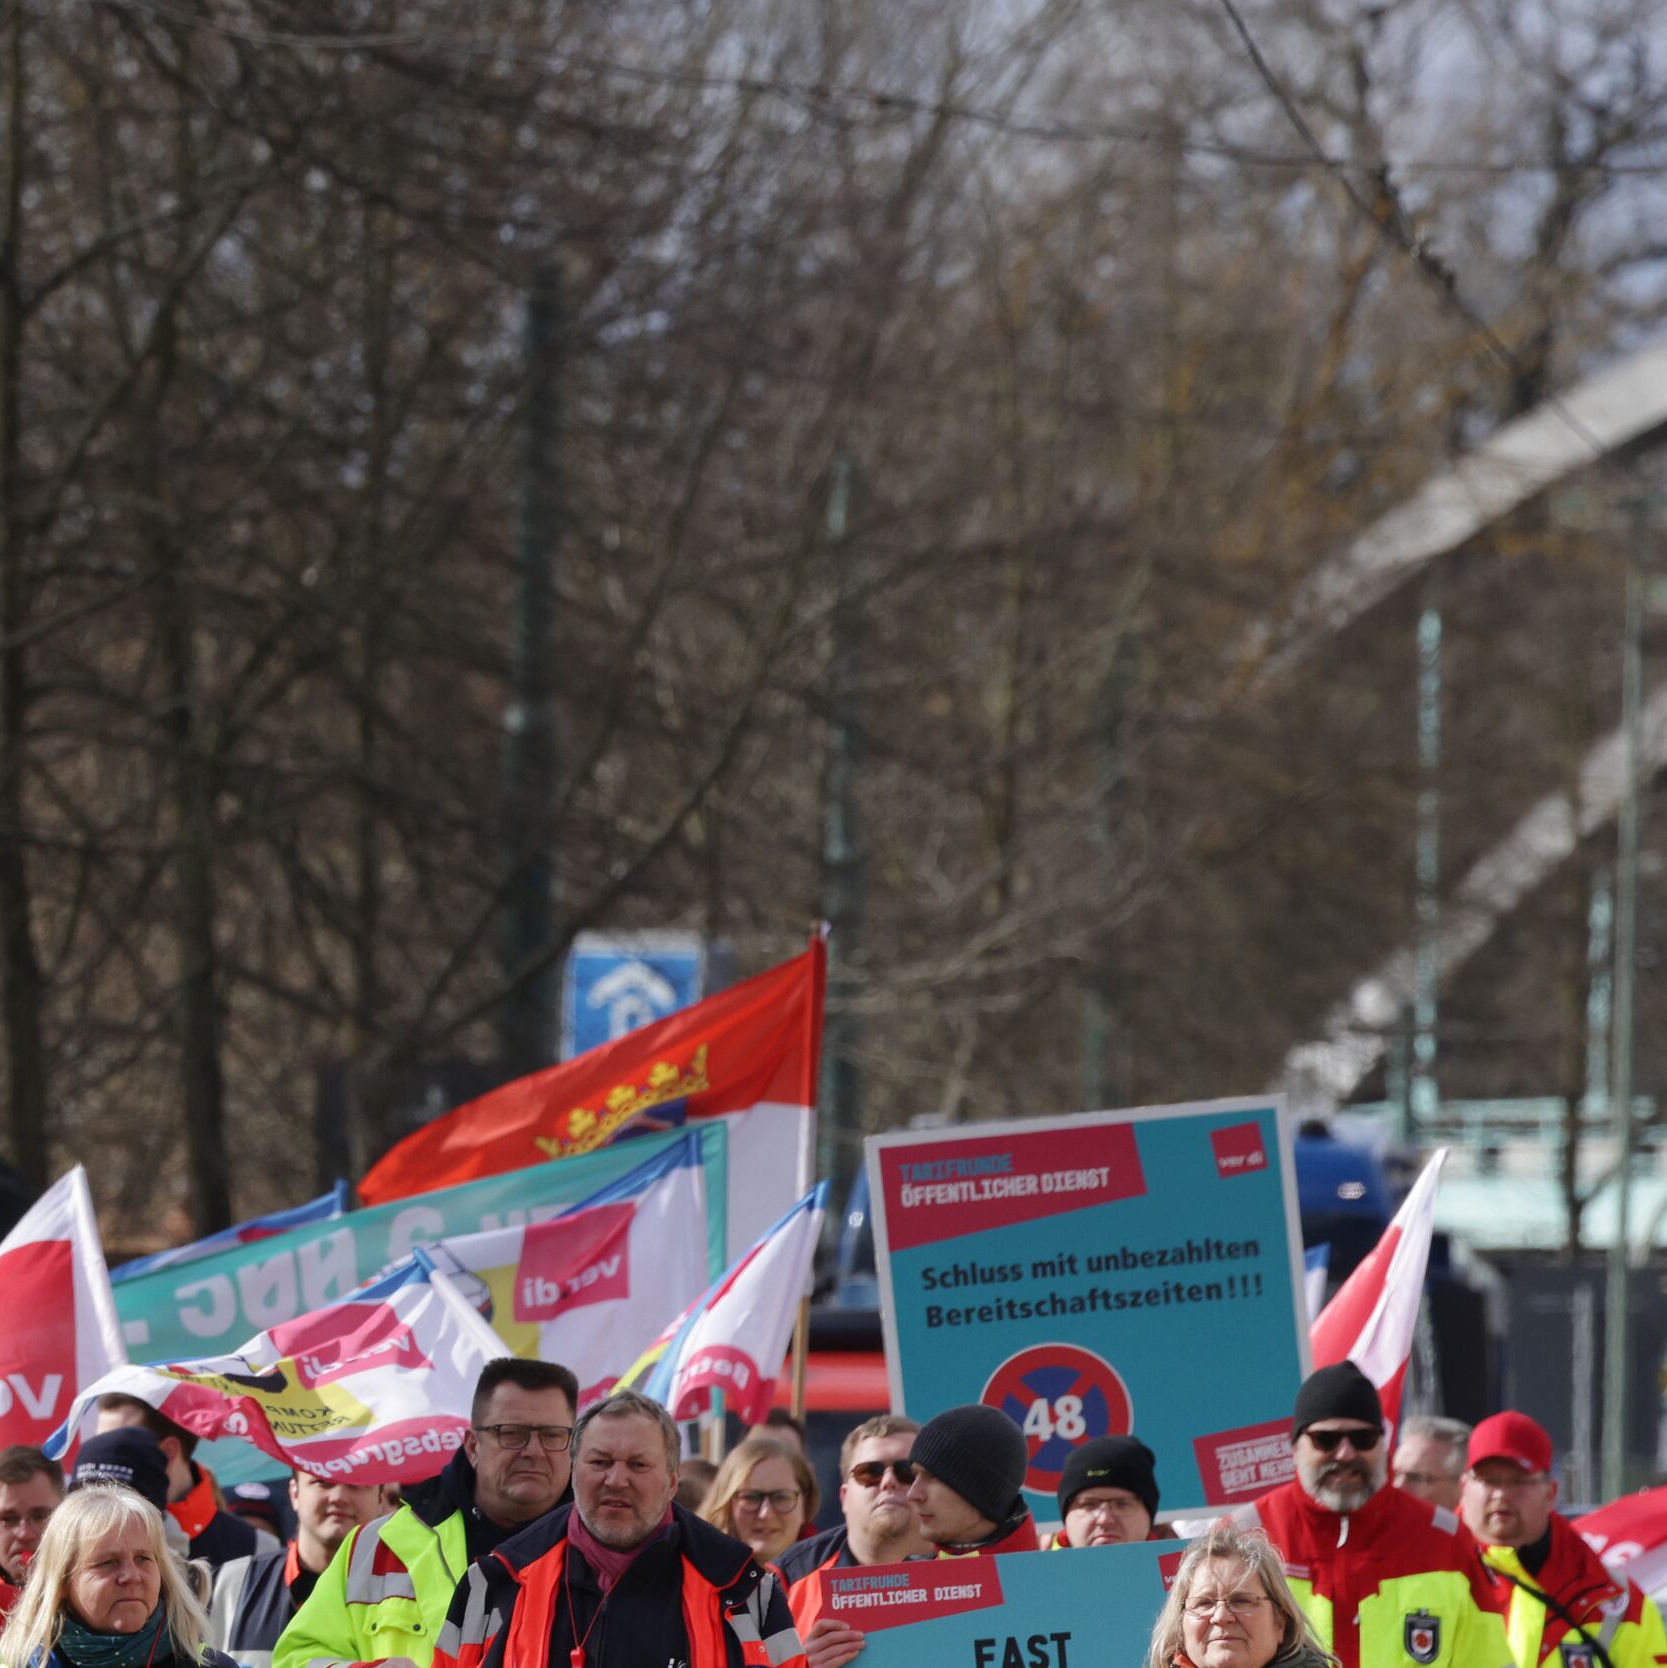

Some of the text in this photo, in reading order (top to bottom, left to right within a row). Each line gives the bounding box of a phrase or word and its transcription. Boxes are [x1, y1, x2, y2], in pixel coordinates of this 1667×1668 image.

[900, 1153, 1013, 1182] TARIFRUNDE
[901, 1166, 1110, 1208] ÖFFENTLICHER DIENST
[921, 1238, 1260, 1290] Schluss mit unbezahlten
[925, 1273, 1265, 1329] Bereitschaftszeiten!!!
[1023, 1394, 1087, 1442] 48
[830, 1573, 911, 1592] TARIFRUNDE
[831, 1583, 983, 1611] ÖFFENTLICHER DIENST
